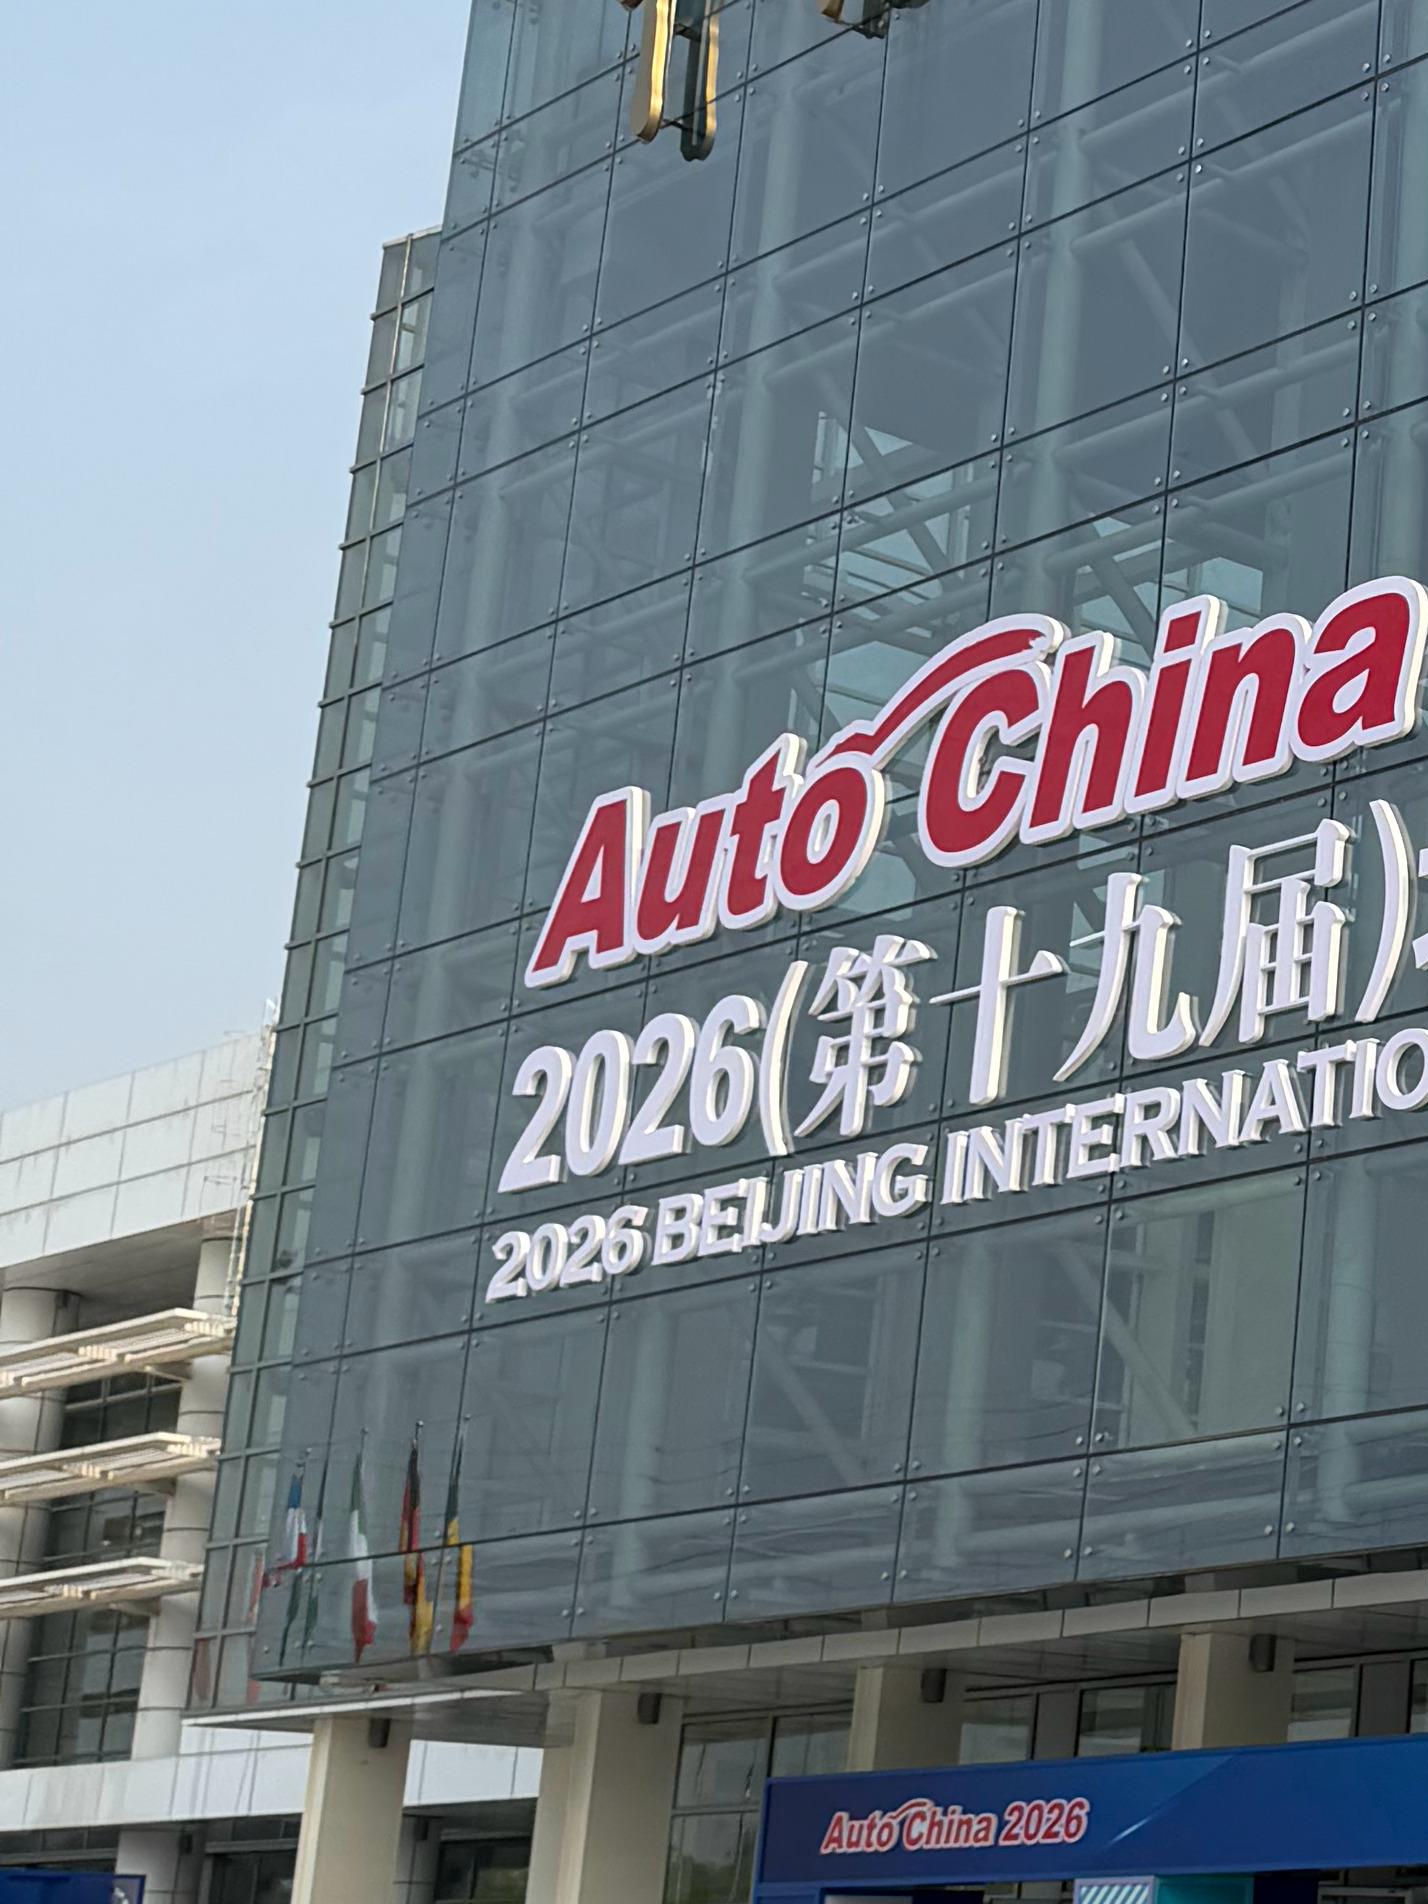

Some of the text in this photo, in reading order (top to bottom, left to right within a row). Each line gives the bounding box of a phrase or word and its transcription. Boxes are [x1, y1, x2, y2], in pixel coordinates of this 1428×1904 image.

[524, 733, 886, 989] Auto
[486, 1205, 649, 1302] 2026
[652, 1144, 930, 1266] BEIJING
[820, 1797, 1090, 1854] Auto China 2026
